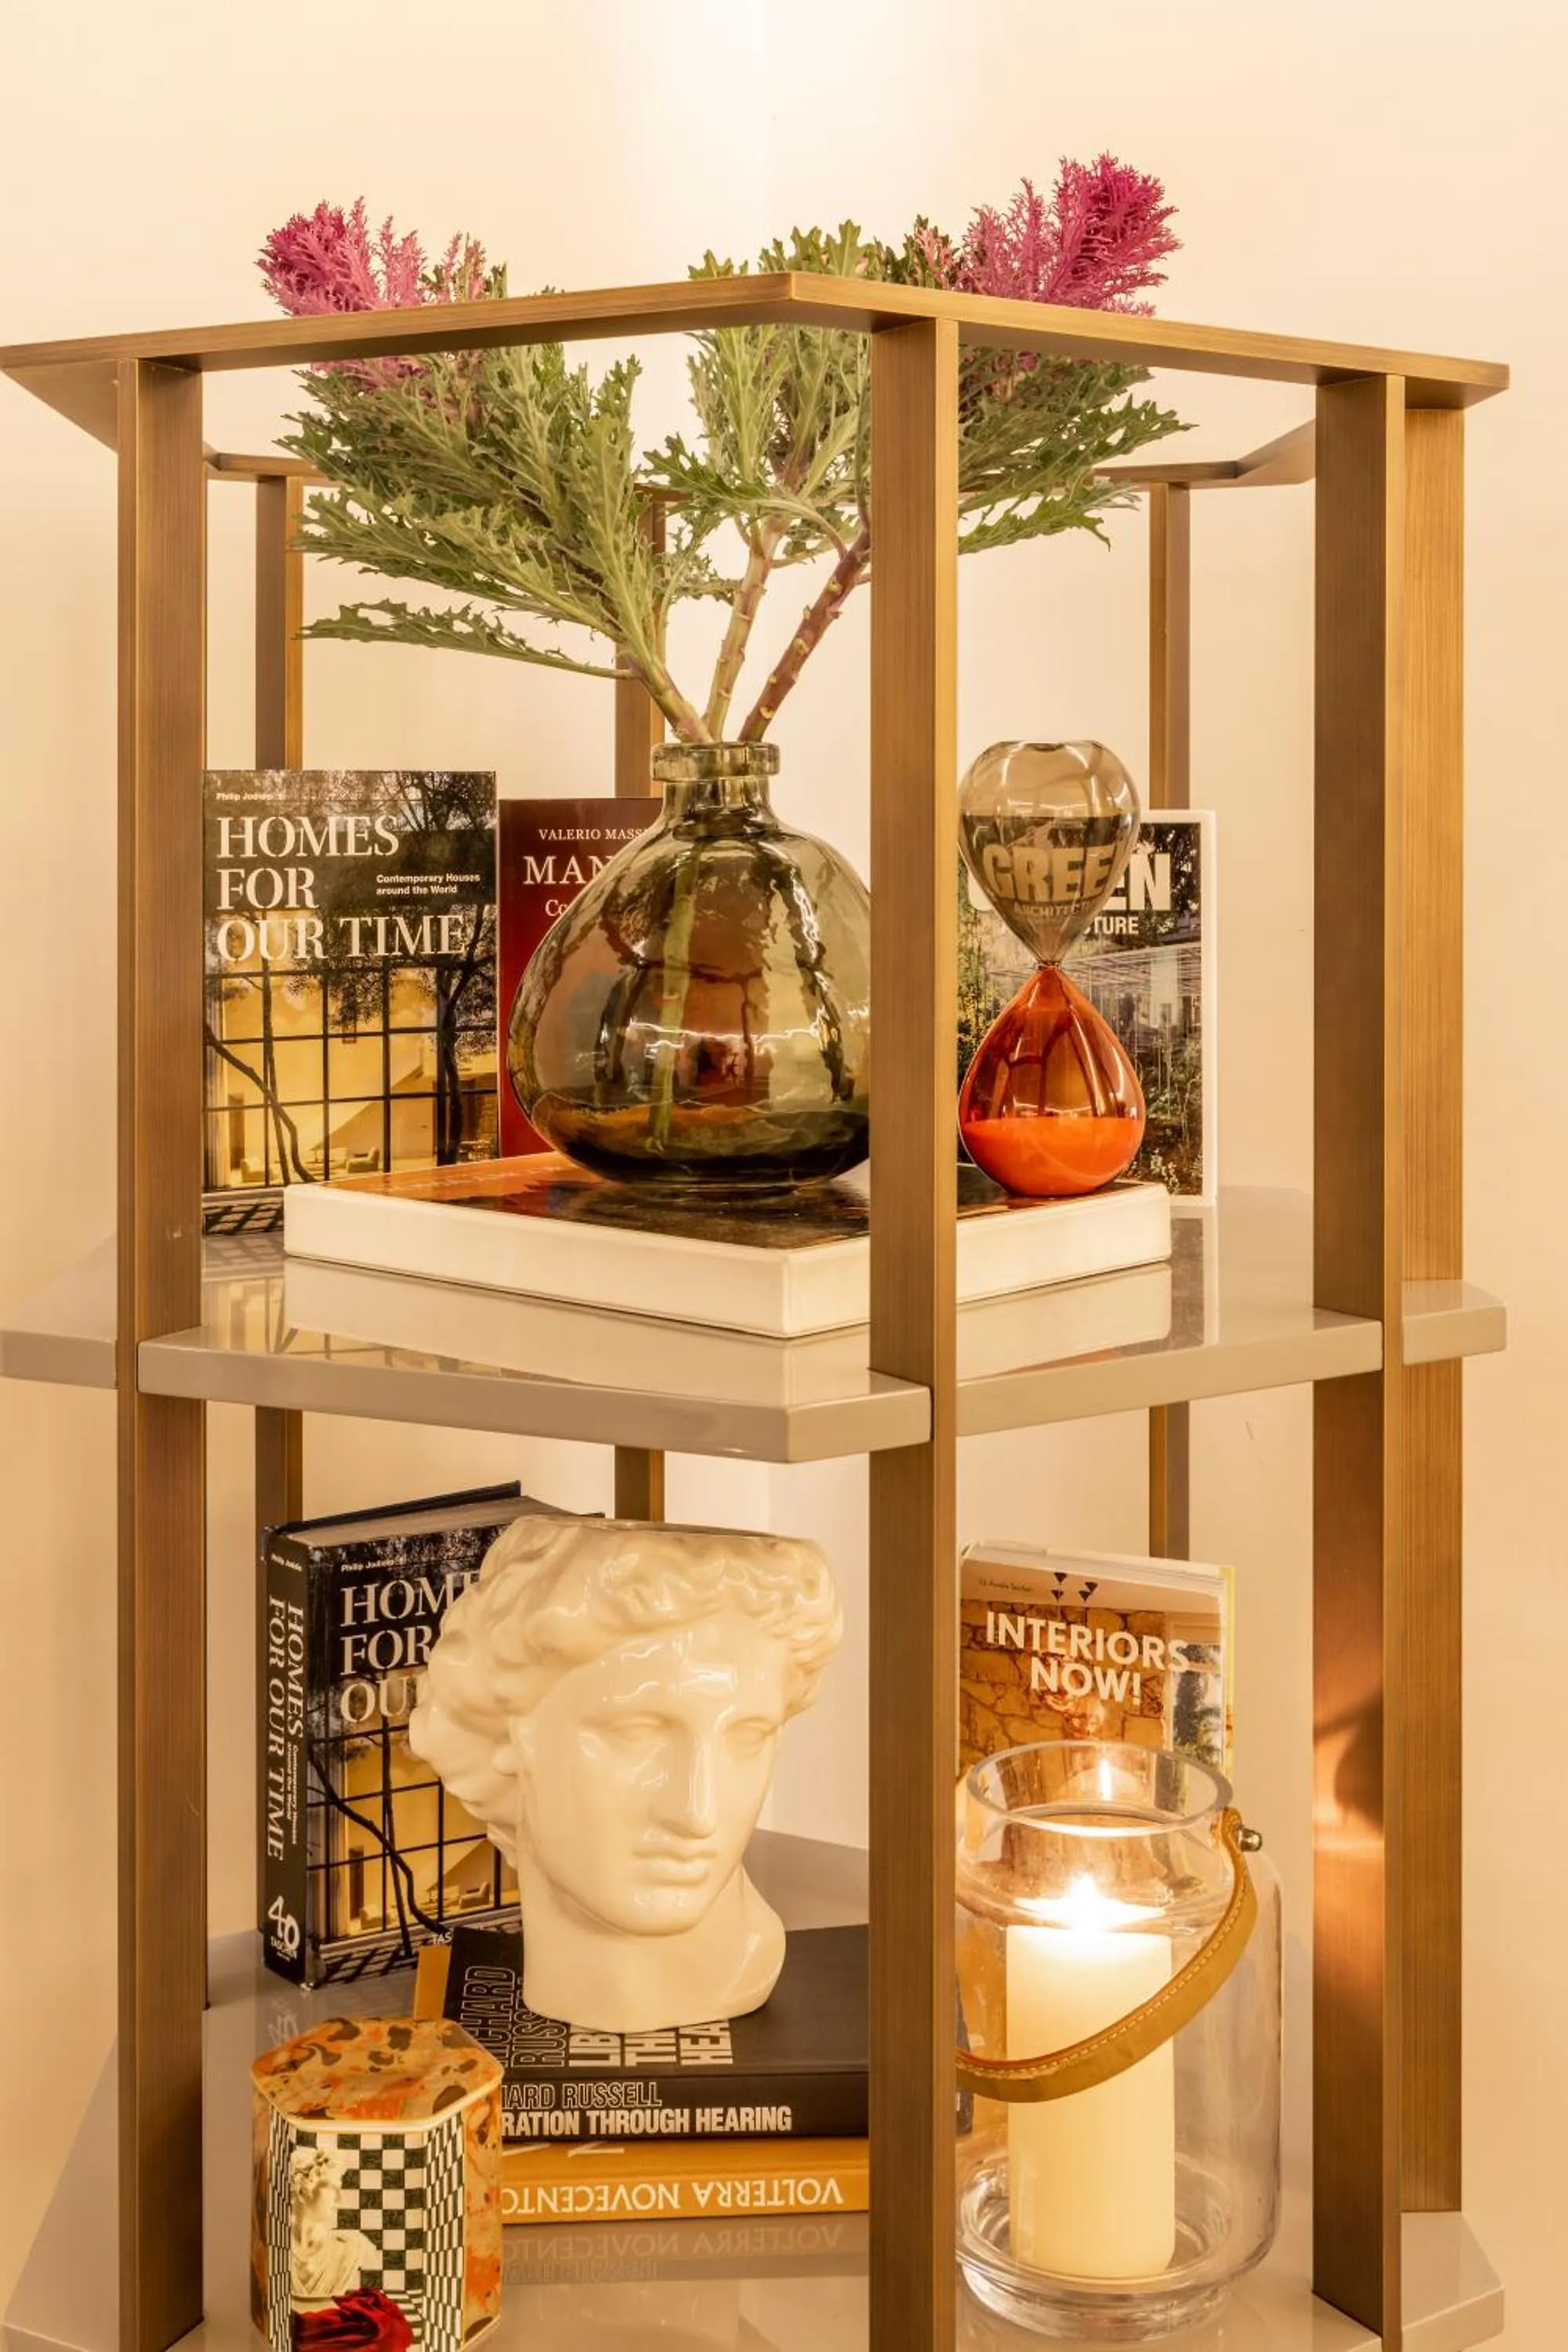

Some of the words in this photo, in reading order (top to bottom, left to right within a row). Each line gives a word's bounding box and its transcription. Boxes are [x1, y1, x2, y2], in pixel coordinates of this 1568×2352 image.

[216, 815, 400, 858] HOMES
[539, 829, 601, 840] VALERIO
[604, 829, 648, 840] MASS
[216, 867, 319, 910] FOR
[376, 874, 444, 884] Contemporary
[445, 873, 481, 882] Houses
[376, 886, 410, 895] around
[412, 885, 429, 895] the
[430, 884, 458, 894] World
[216, 917, 327, 962] OUR
[340, 914, 466, 958] TIME
[269, 1595, 285, 1668] FOR
[339, 1624, 432, 1676] FOR
[986, 1610, 1190, 1673] INTERIORS
[287, 1601, 304, 1738] HOMES
[1029, 1656, 1142, 1706] NOW!
[269, 1678, 285, 1757] OUR
[267, 1767, 285, 1860] TIME
[268, 1895, 300, 1951] 40
[460, 1965, 515, 2067] CHARD
[562, 2082, 662, 2109] RUSSELL
[502, 2110, 579, 2136] RATION
[586, 2108, 690, 2135] THROUGH
[695, 2105, 792, 2132] HEARING
[502, 2183, 681, 2215] NOVECENTO
[691, 2177, 844, 2209] VOLTERRA
